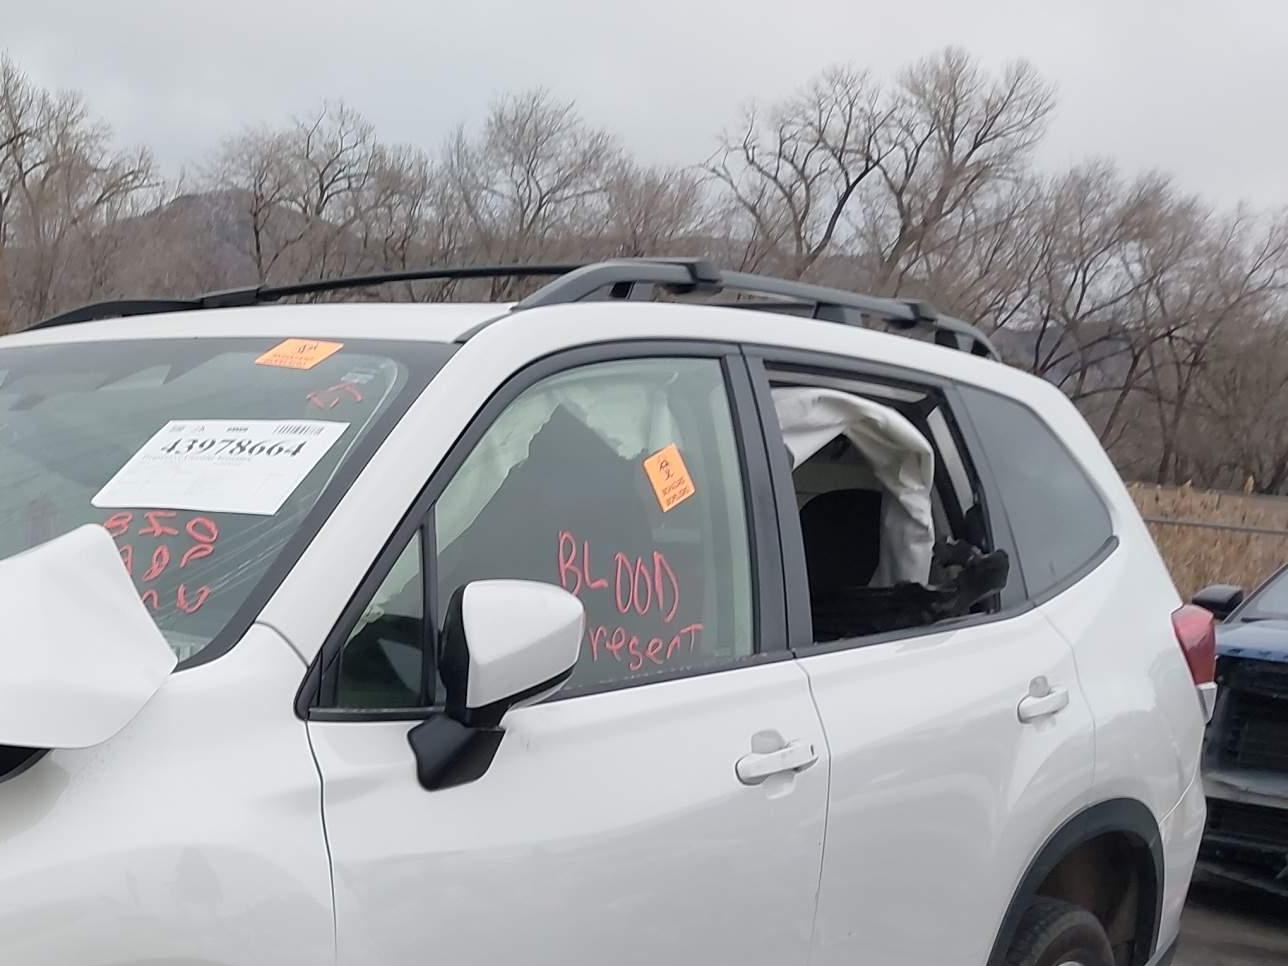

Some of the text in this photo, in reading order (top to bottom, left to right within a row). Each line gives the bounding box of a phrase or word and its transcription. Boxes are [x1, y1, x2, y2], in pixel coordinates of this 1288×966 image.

[161, 437, 307, 458] 43978664
[558, 529, 679, 622] BLOOD
[587, 622, 705, 671] resenT
